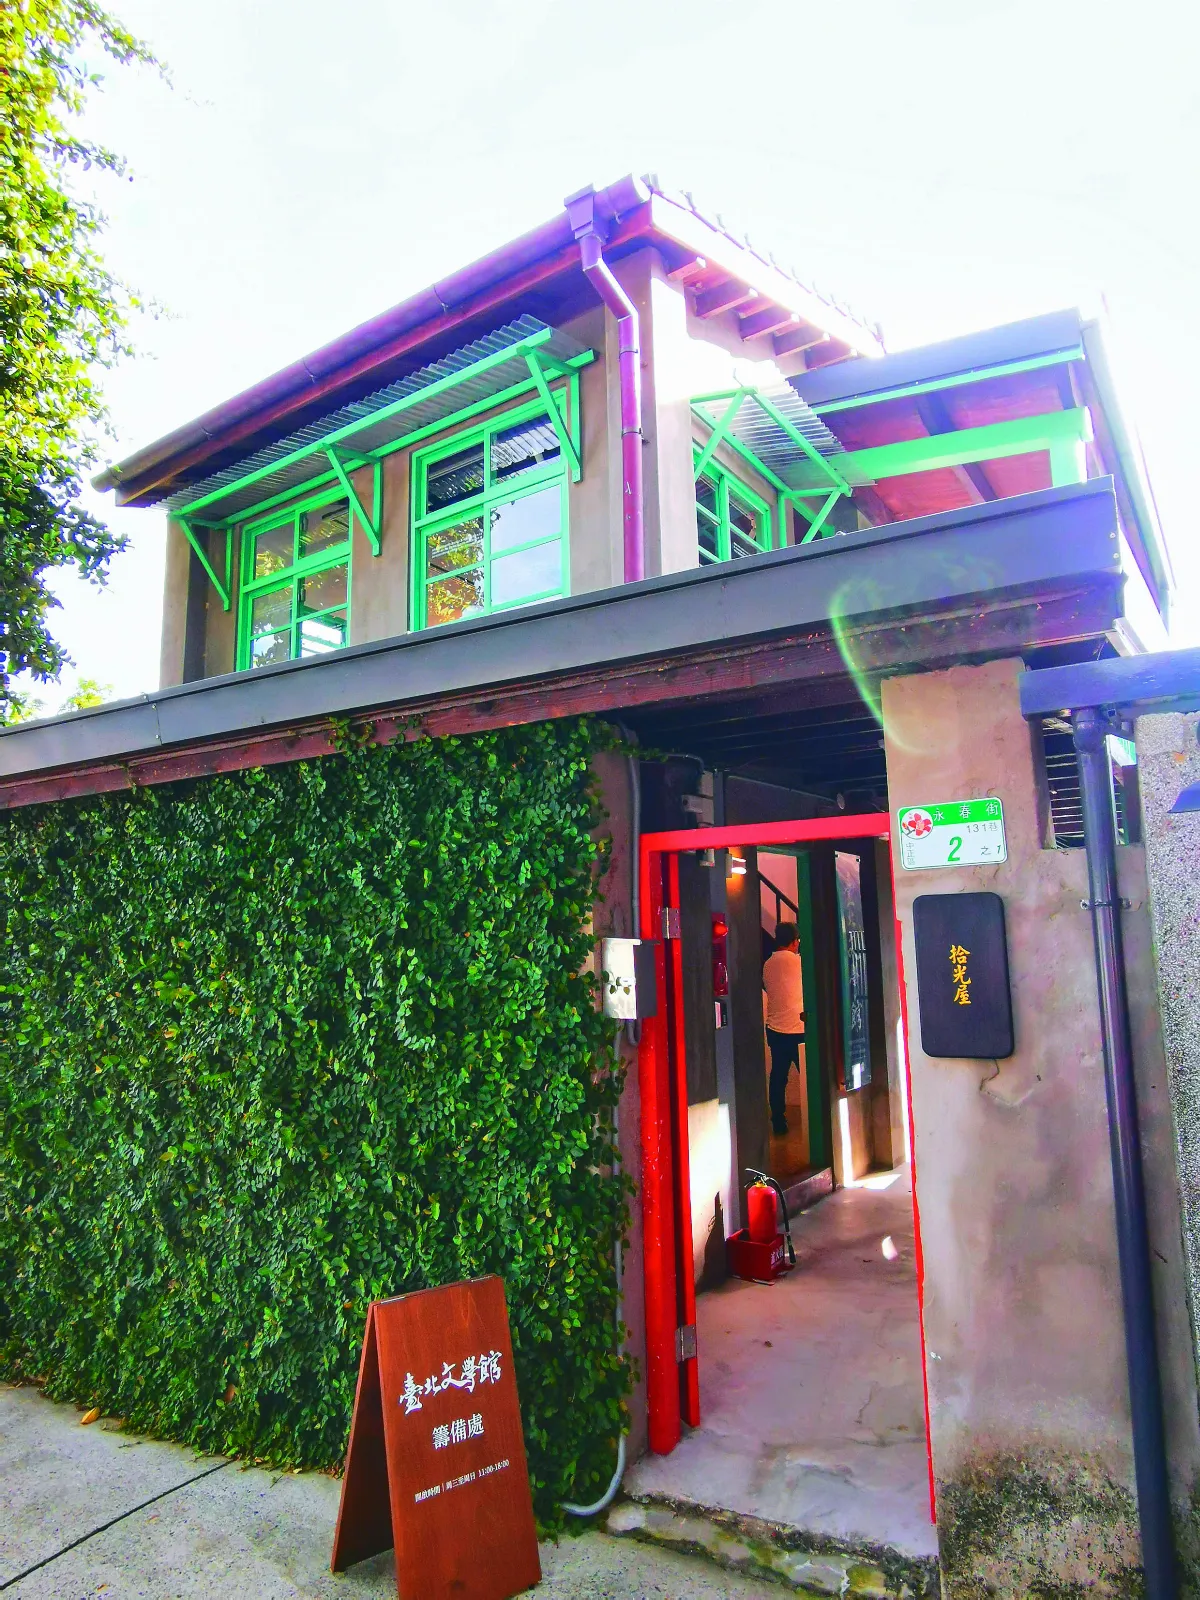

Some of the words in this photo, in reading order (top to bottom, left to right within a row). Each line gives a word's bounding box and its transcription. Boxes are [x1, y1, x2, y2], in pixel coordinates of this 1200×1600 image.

[933, 801, 999, 821] 永春街
[947, 836, 963, 862] 2
[949, 944, 972, 1006] 拾光屋
[399, 1350, 503, 1416] 臺北文學館
[432, 1413, 485, 1450] 籌備處
